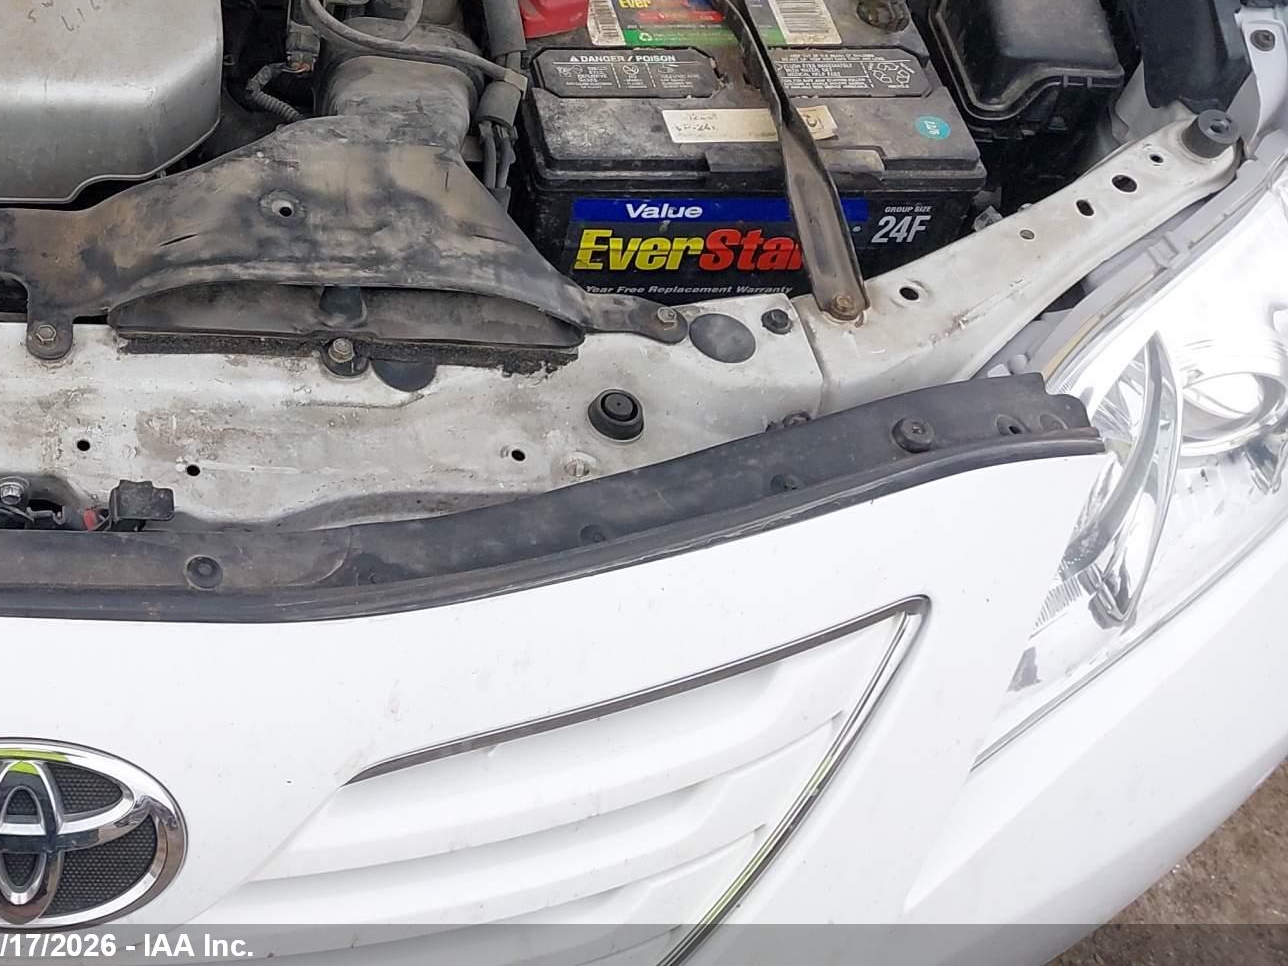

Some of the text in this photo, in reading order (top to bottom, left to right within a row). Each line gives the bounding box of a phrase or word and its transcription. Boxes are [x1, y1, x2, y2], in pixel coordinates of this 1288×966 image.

[580, 55, 625, 63] DANGER
[635, 55, 677, 63] POISON
[625, 203, 703, 219] Value
[884, 205, 933, 213] GROUP SIZE
[871, 215, 932, 243] 24F
[586, 285, 794, 295] Year Free Replacement Warranty
